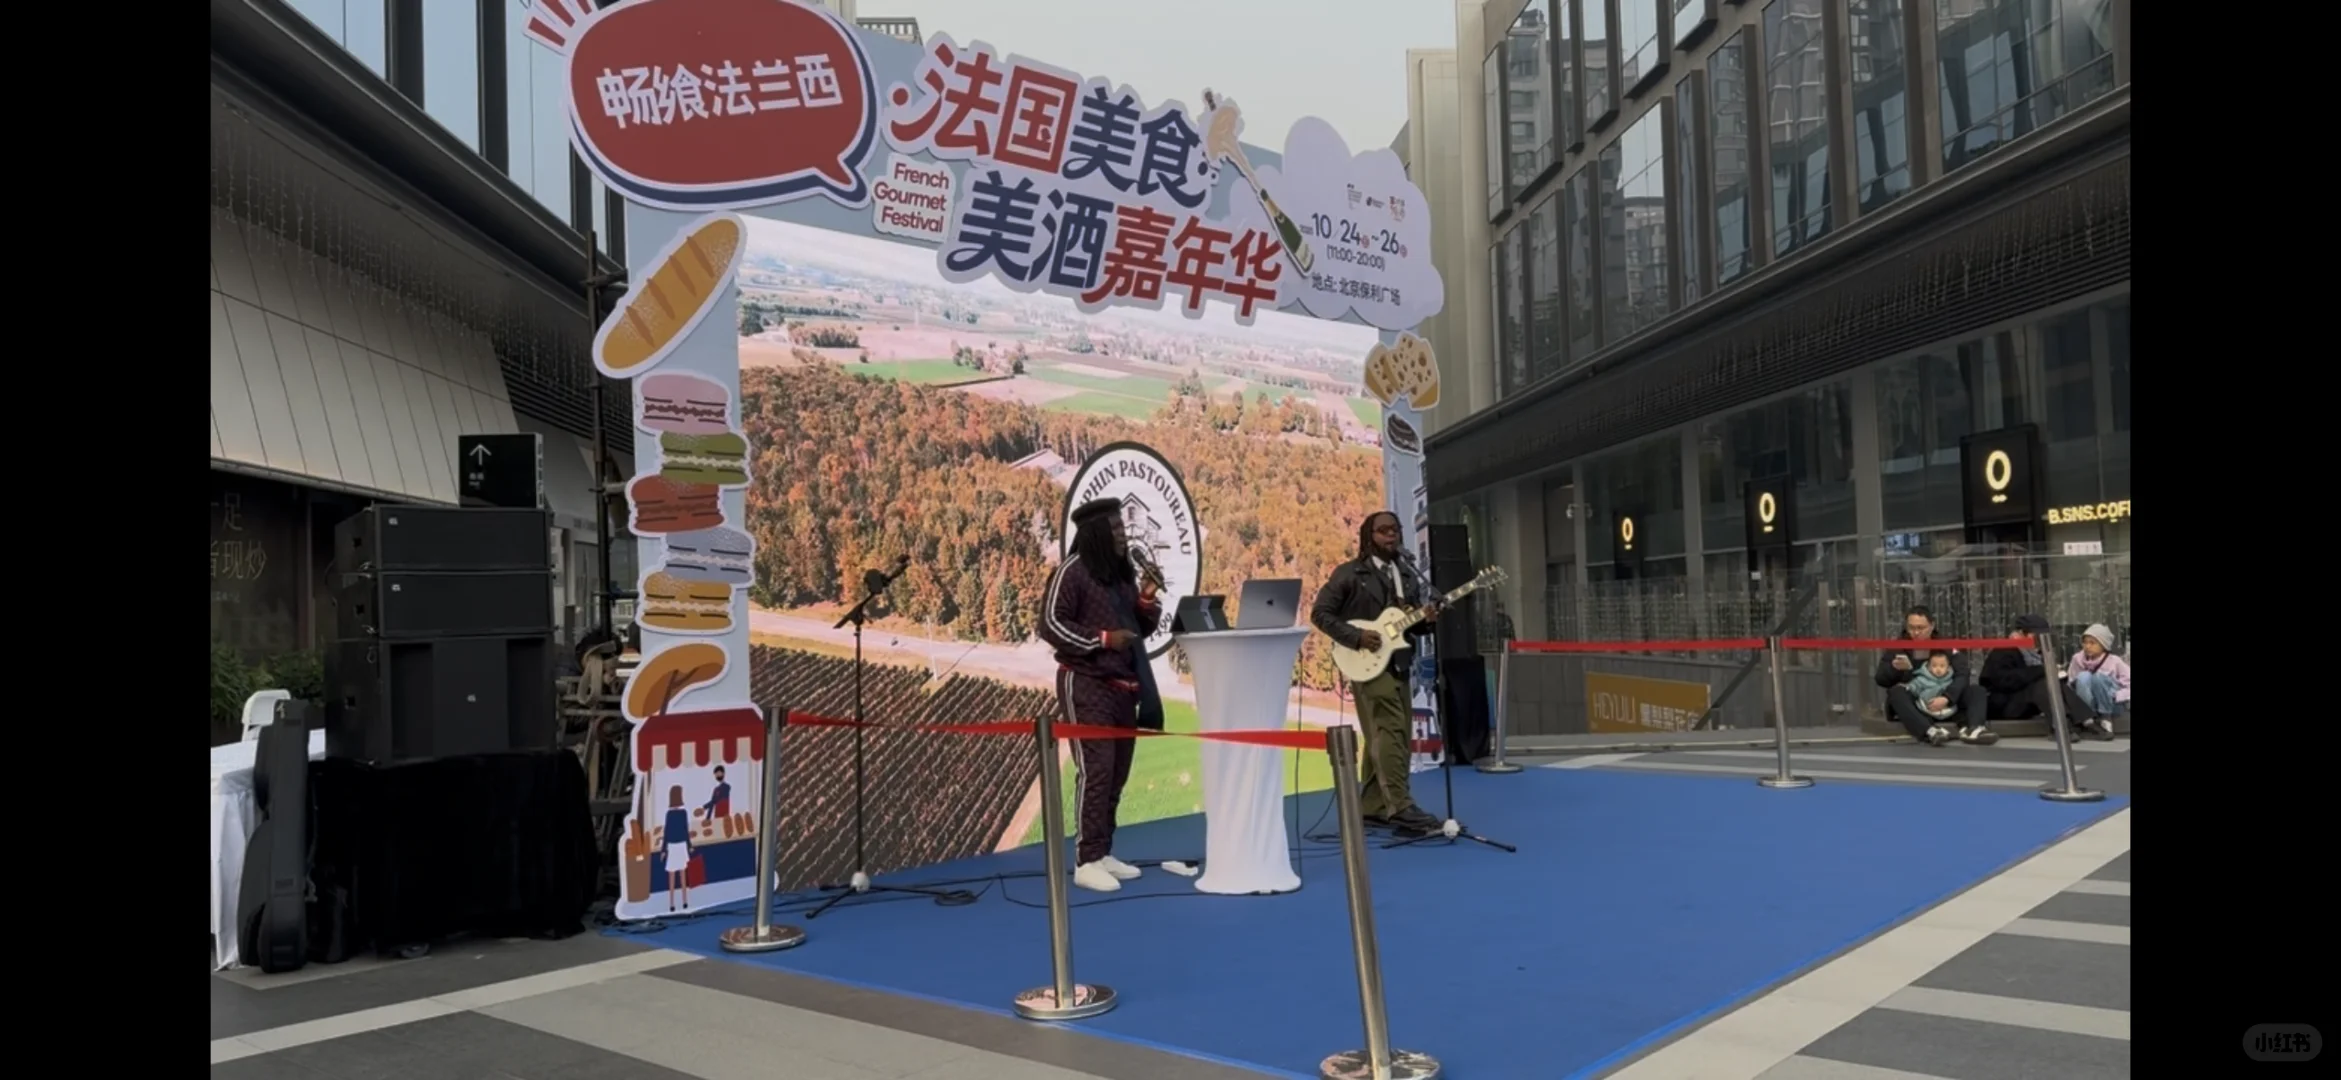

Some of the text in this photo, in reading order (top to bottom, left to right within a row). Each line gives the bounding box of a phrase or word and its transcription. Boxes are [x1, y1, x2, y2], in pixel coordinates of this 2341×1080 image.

[596, 53, 843, 129] 畅飨法兰西
[891, 43, 1207, 208] 法国美食
[874, 181, 947, 211] Gourmet
[894, 162, 949, 190] French
[881, 206, 944, 233] Festival
[946, 170, 1282, 318] 美酒嘉年华
[1080, 459, 1192, 556] PHIN PASTOUREAU
